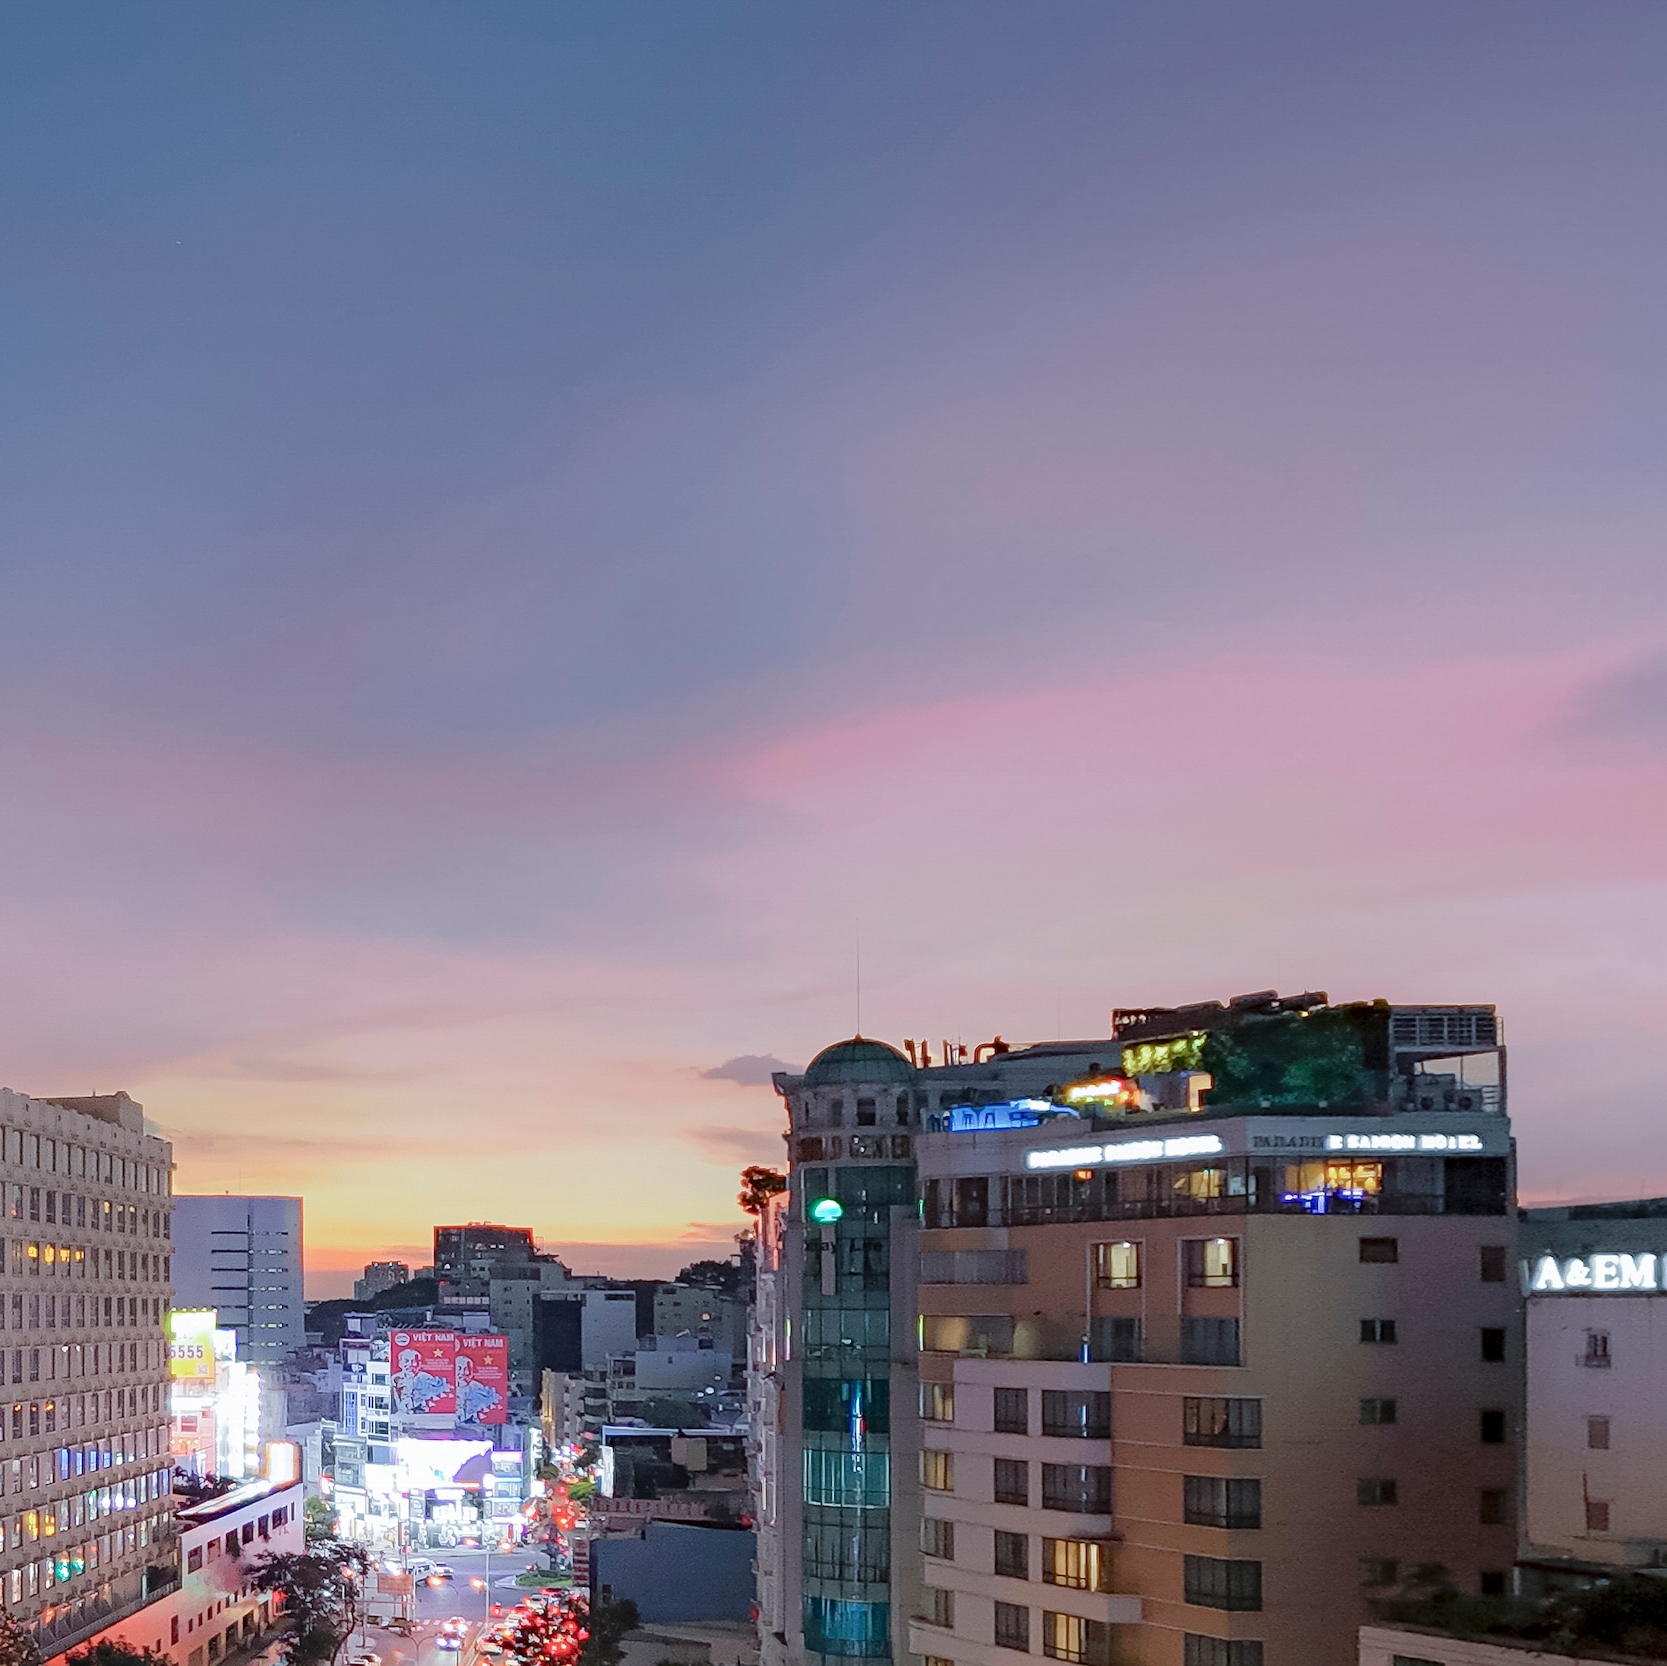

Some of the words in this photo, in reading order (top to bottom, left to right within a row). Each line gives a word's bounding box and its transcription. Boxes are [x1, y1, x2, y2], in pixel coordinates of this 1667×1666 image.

[1532, 1253, 1657, 1290] A&EM
[435, 1333, 455, 1342] NAM
[484, 1338, 504, 1347] NAM
